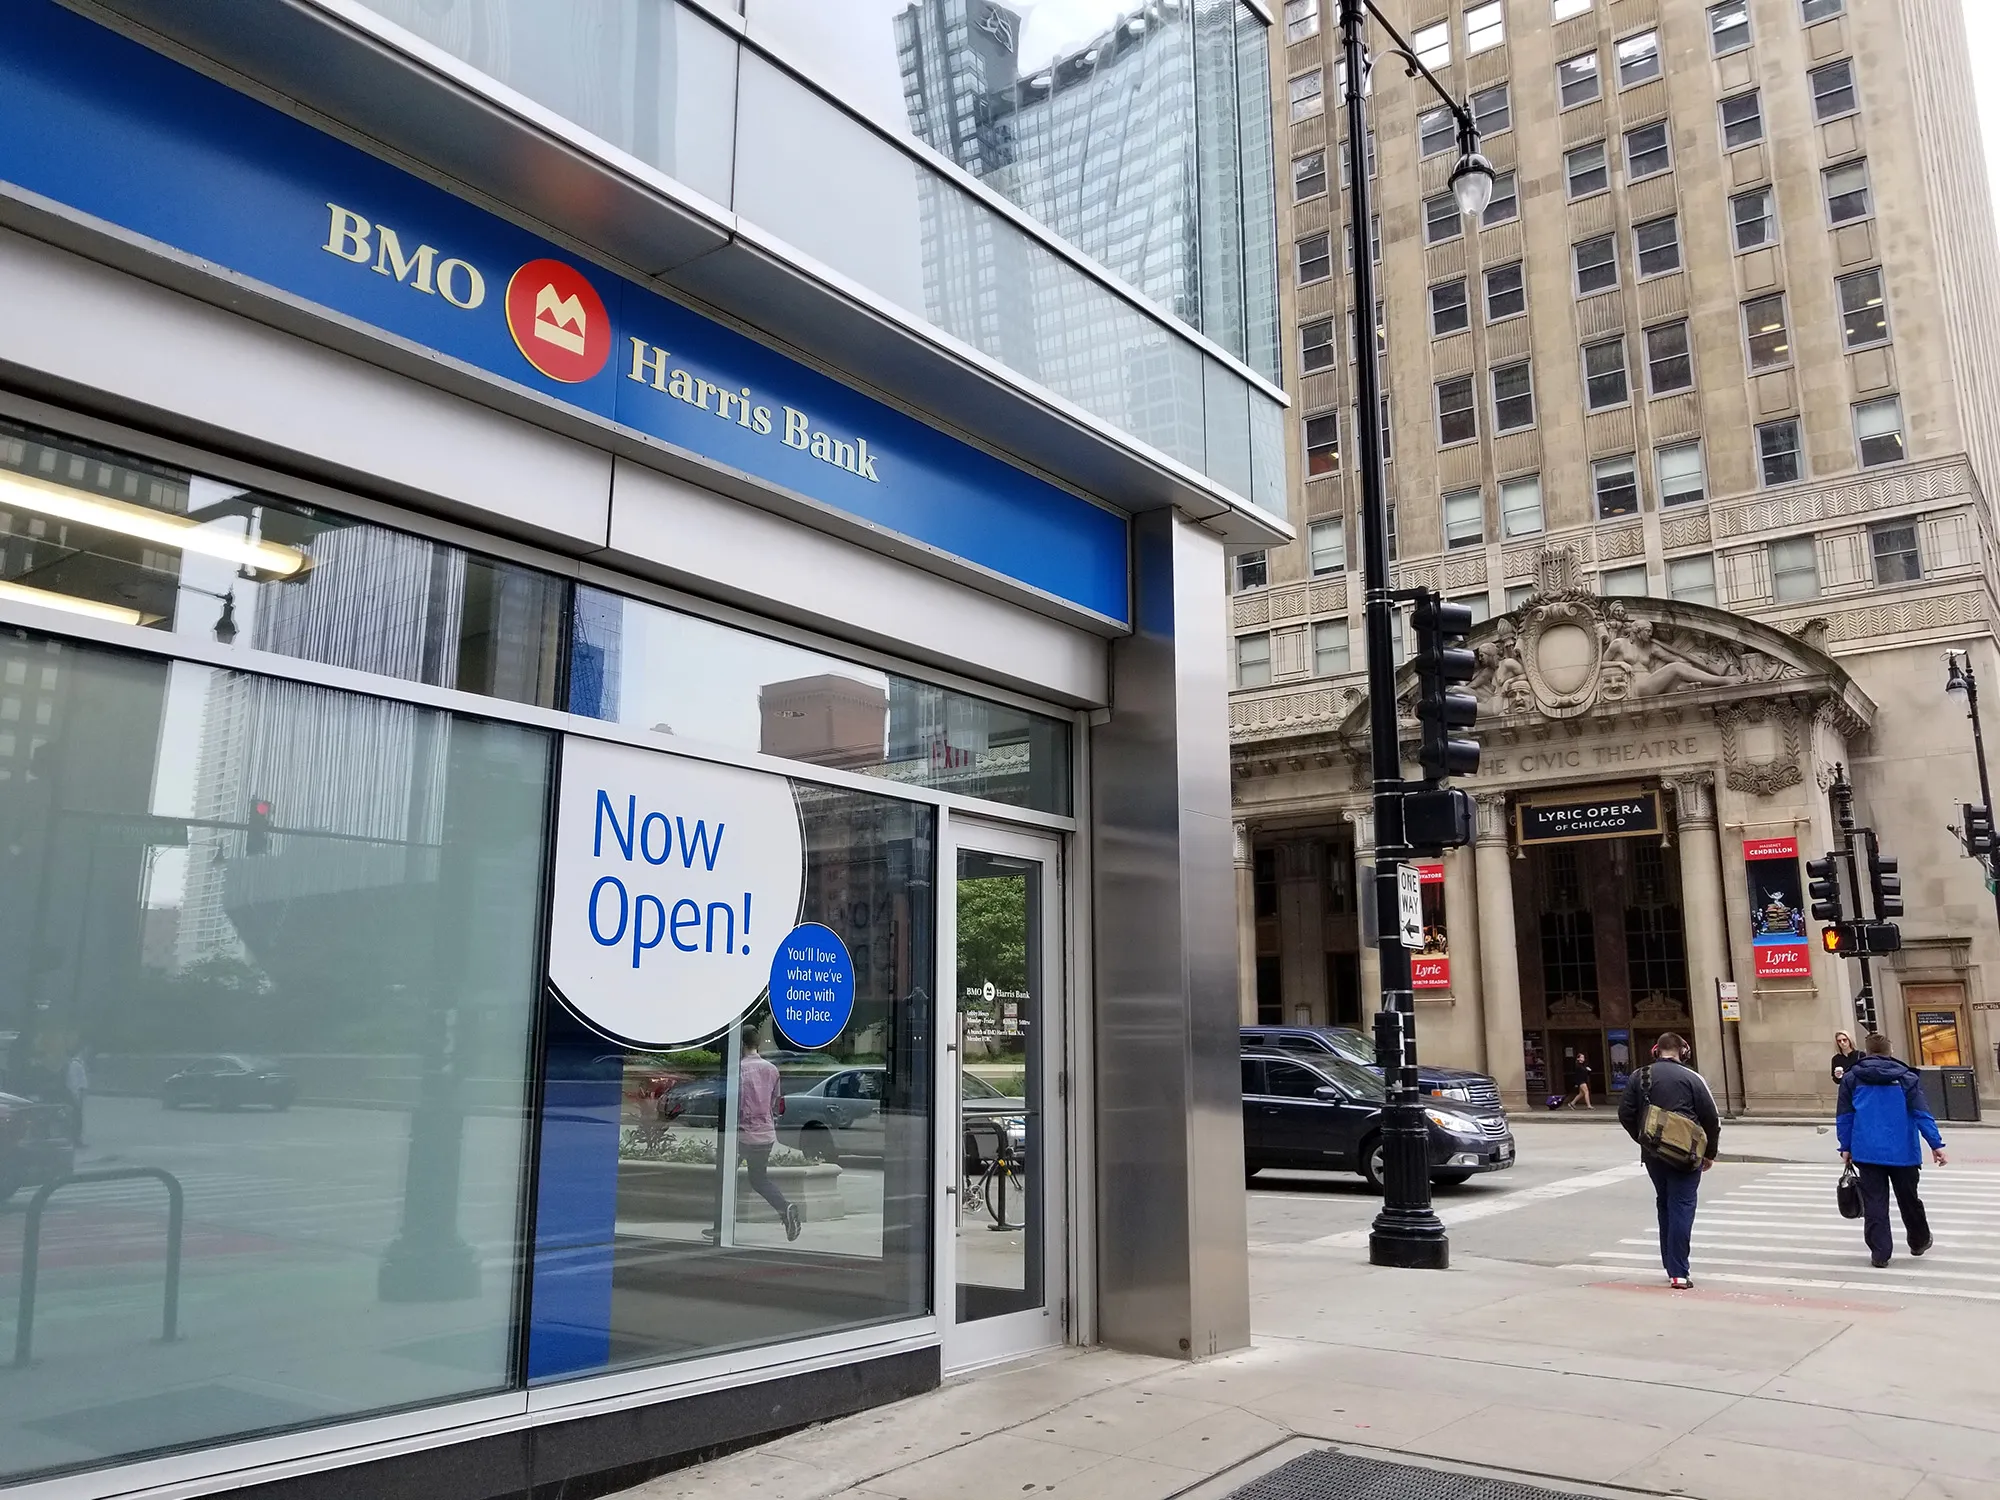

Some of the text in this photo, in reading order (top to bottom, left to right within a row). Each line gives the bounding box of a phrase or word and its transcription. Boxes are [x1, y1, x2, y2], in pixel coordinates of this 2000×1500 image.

[322, 202, 879, 482] BMO Harris Bank
[1480, 737, 1698, 777] HE CIVIC THEATRE
[1538, 804, 1643, 823] LYRIC OPERA
[594, 789, 725, 871] Now
[1555, 818, 1626, 832] OF CHICAGO
[1749, 847, 1793, 855] CENDRILLON
[1401, 872, 1418, 893] ONE
[1418, 872, 1442, 880] OVATORE
[1402, 894, 1419, 915] WAY
[588, 876, 752, 969] Open!
[787, 947, 836, 964] You'll love
[1766, 950, 1798, 965] Lyric
[787, 966, 842, 983] what we've
[1415, 964, 1441, 977] Lyric
[786, 986, 835, 1002] done with
[966, 987, 1030, 999] BMO Harris Bank
[786, 1006, 833, 1025] the place.
